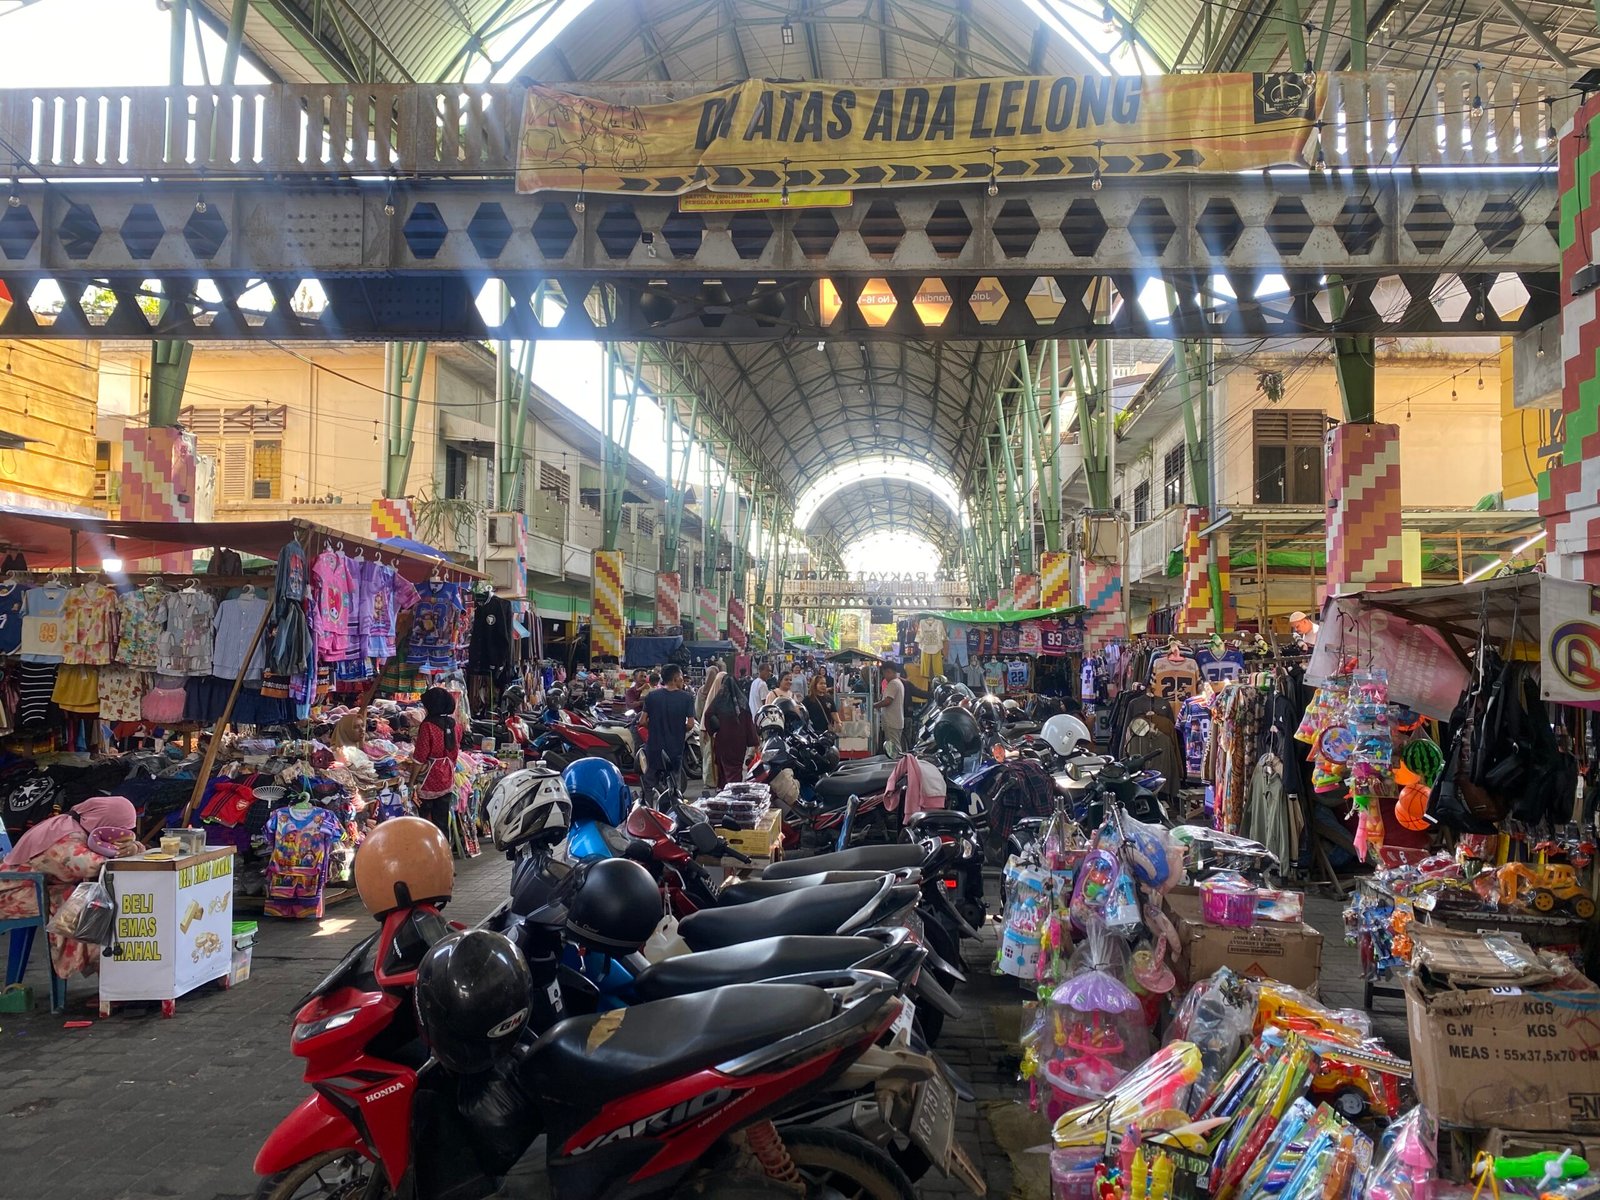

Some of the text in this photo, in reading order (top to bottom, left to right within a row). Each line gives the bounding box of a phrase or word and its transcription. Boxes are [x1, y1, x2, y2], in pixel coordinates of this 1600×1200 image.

[694, 75, 1143, 151] DI ATAS ADA LELONG
[1047, 633, 1062, 646] 93
[1011, 671, 1025, 683] 22
[178, 854, 232, 890] BELI EMAS MAHAL
[121, 893, 154, 914] BELI
[118, 916, 157, 938] EMAS
[1524, 1001, 1554, 1016] KGS
[498, 1013, 525, 1032] GM
[1446, 1023, 1474, 1037] G.W
[1527, 1024, 1557, 1038] KGS
[1449, 1044, 1490, 1060] MEAS
[1503, 1049, 1577, 1064] 55x37,5x70
[365, 1082, 405, 1104] HONDA
[923, 1084, 939, 1123] 2751
[570, 1086, 732, 1156] VARIO
